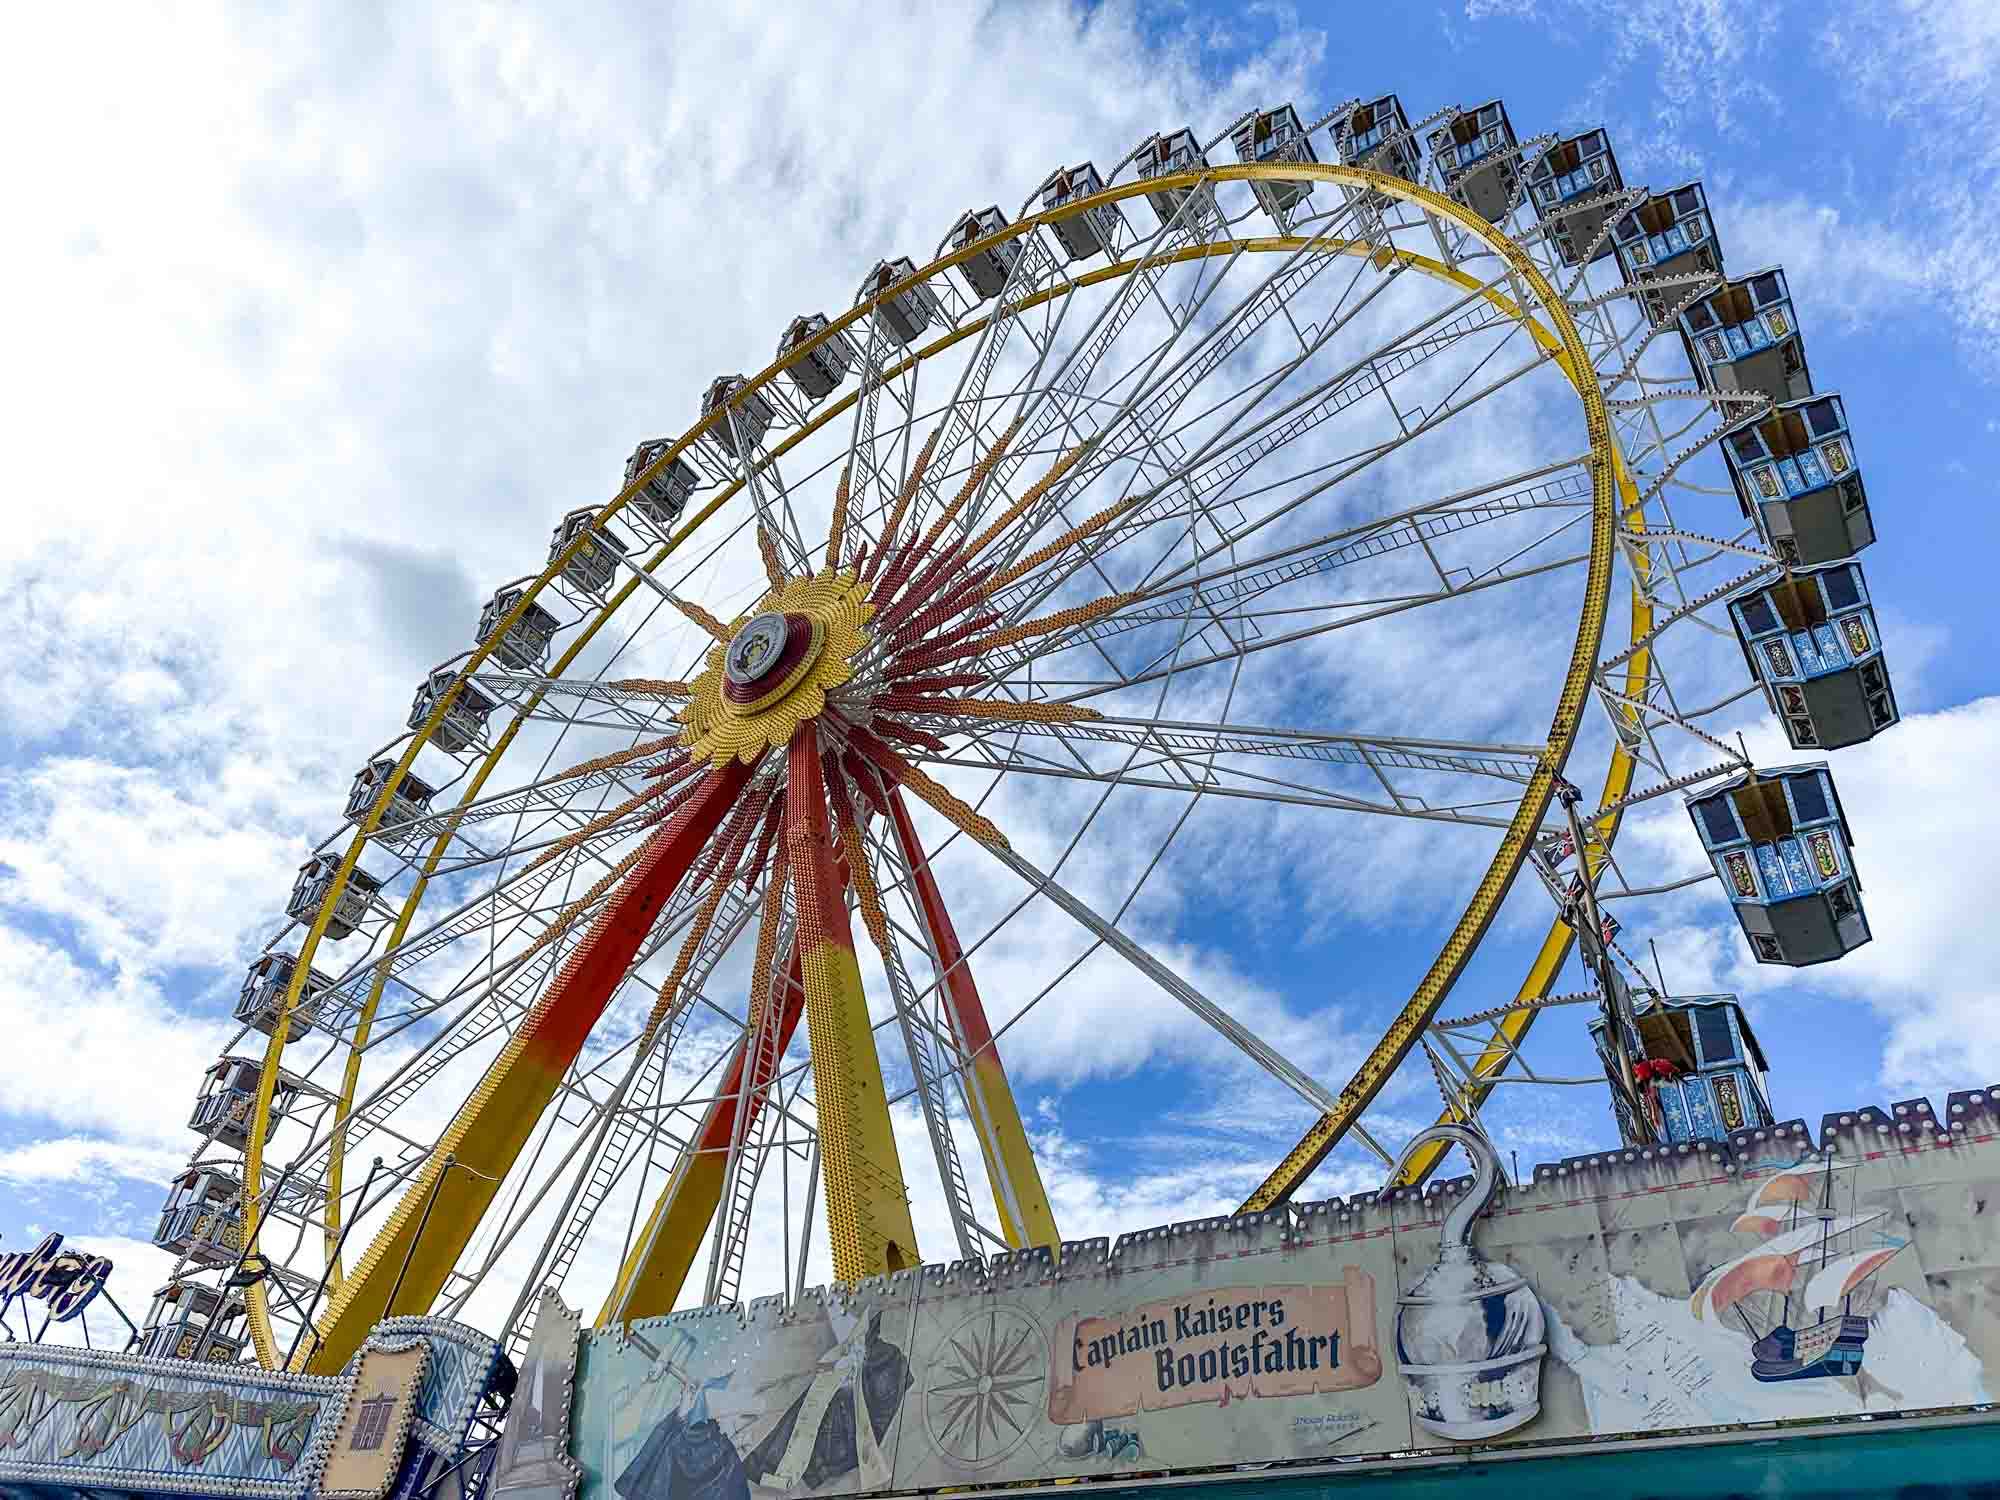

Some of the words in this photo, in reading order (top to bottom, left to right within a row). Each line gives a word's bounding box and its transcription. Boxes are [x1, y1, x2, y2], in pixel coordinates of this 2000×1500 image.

[1072, 1313, 1168, 1372] Captain
[1174, 1298, 1285, 1342] Kaisers
[1155, 1327, 1341, 1392] Bootsfahrt
